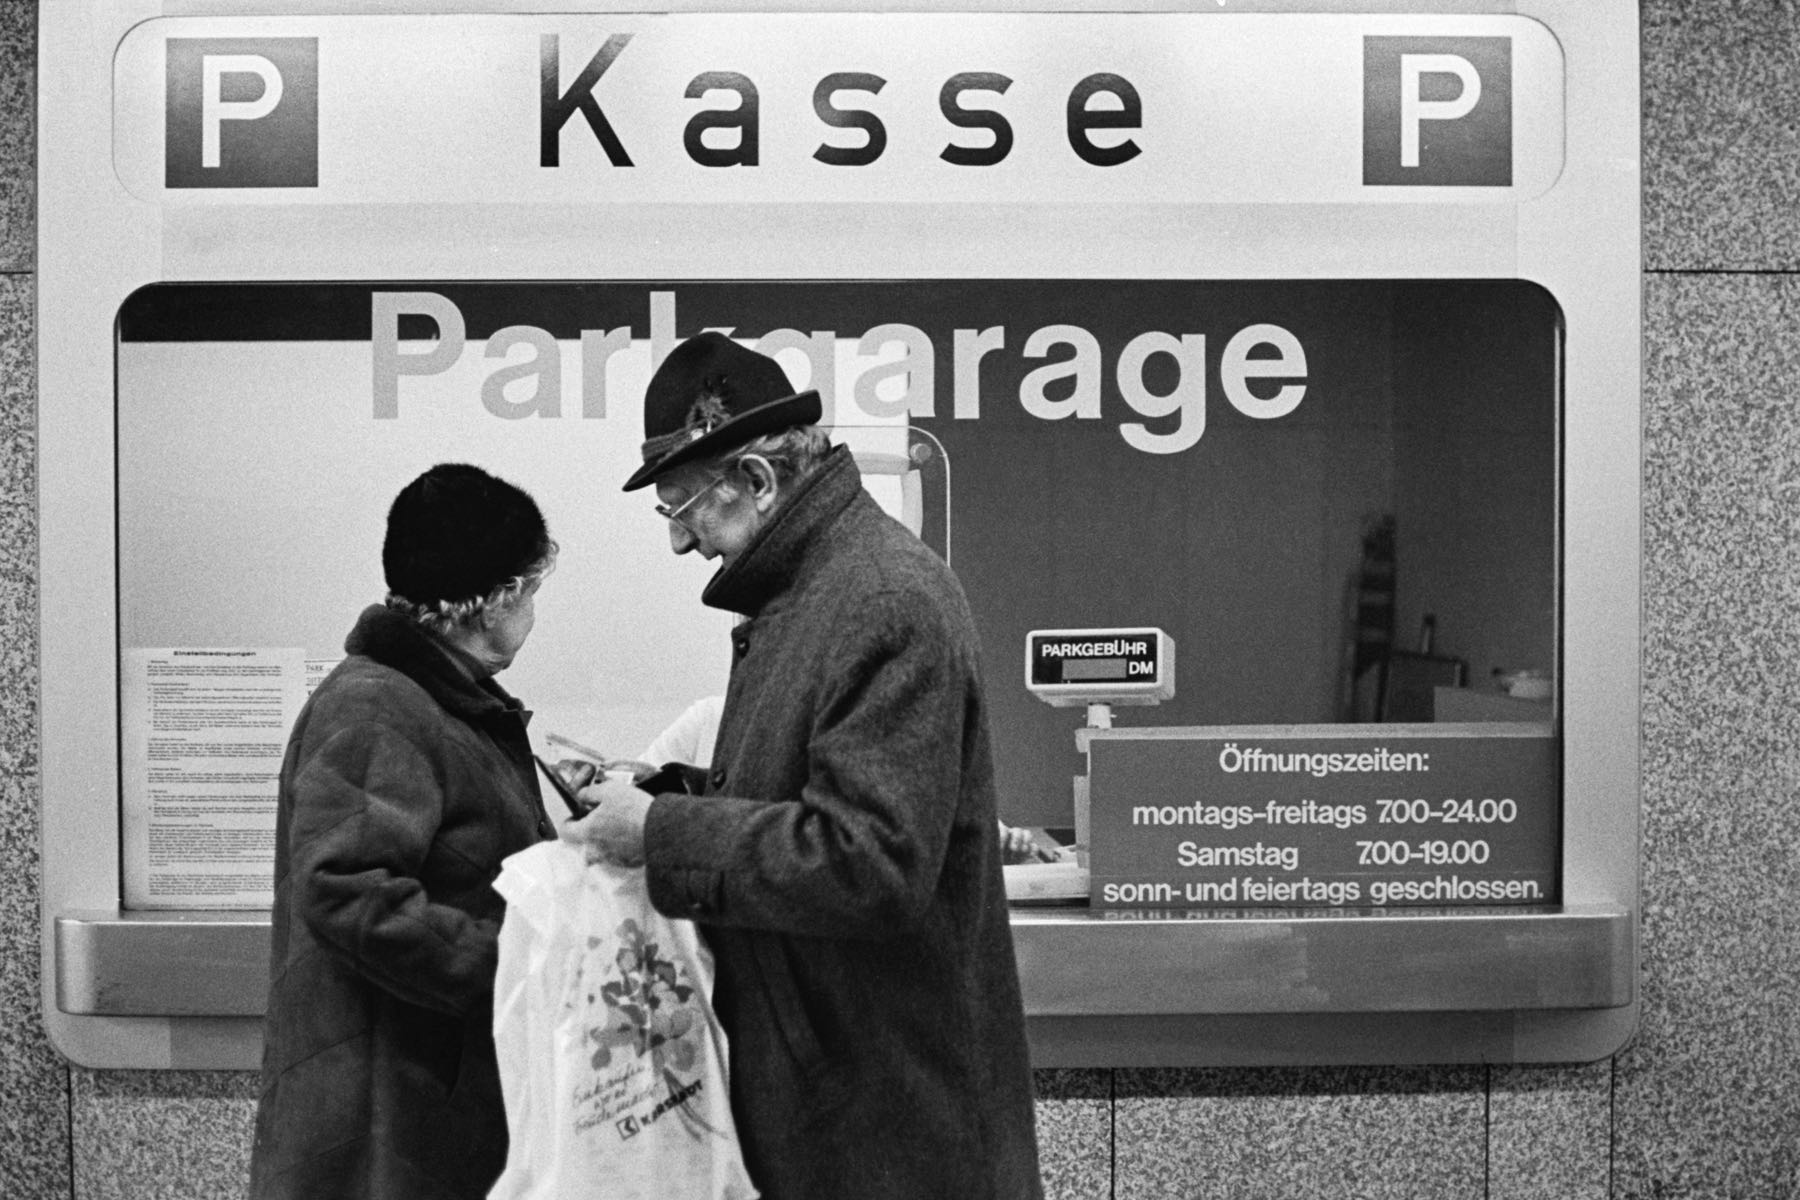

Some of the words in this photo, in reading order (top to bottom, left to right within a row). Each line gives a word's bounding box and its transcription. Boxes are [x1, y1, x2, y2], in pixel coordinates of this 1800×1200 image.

[202, 54, 283, 168] P
[540, 33, 1143, 167] Kasse
[1400, 53, 1482, 168] P
[1042, 639, 1147, 657] PARKGEBÜHR
[1128, 661, 1154, 675] DM
[1219, 743, 1430, 777] Öffnungszeiten:
[1376, 798, 1518, 824] 7.00-24.00
[1177, 841, 1299, 871] Samstag
[1356, 840, 1490, 865] 7.00-19.00
[1103, 881, 1181, 902] sonn-
[1186, 877, 1238, 902] und
[1242, 876, 1361, 905] feiertags
[1369, 875, 1544, 904] geschlossen.
[640, 1079, 703, 1126] KARSTADT
